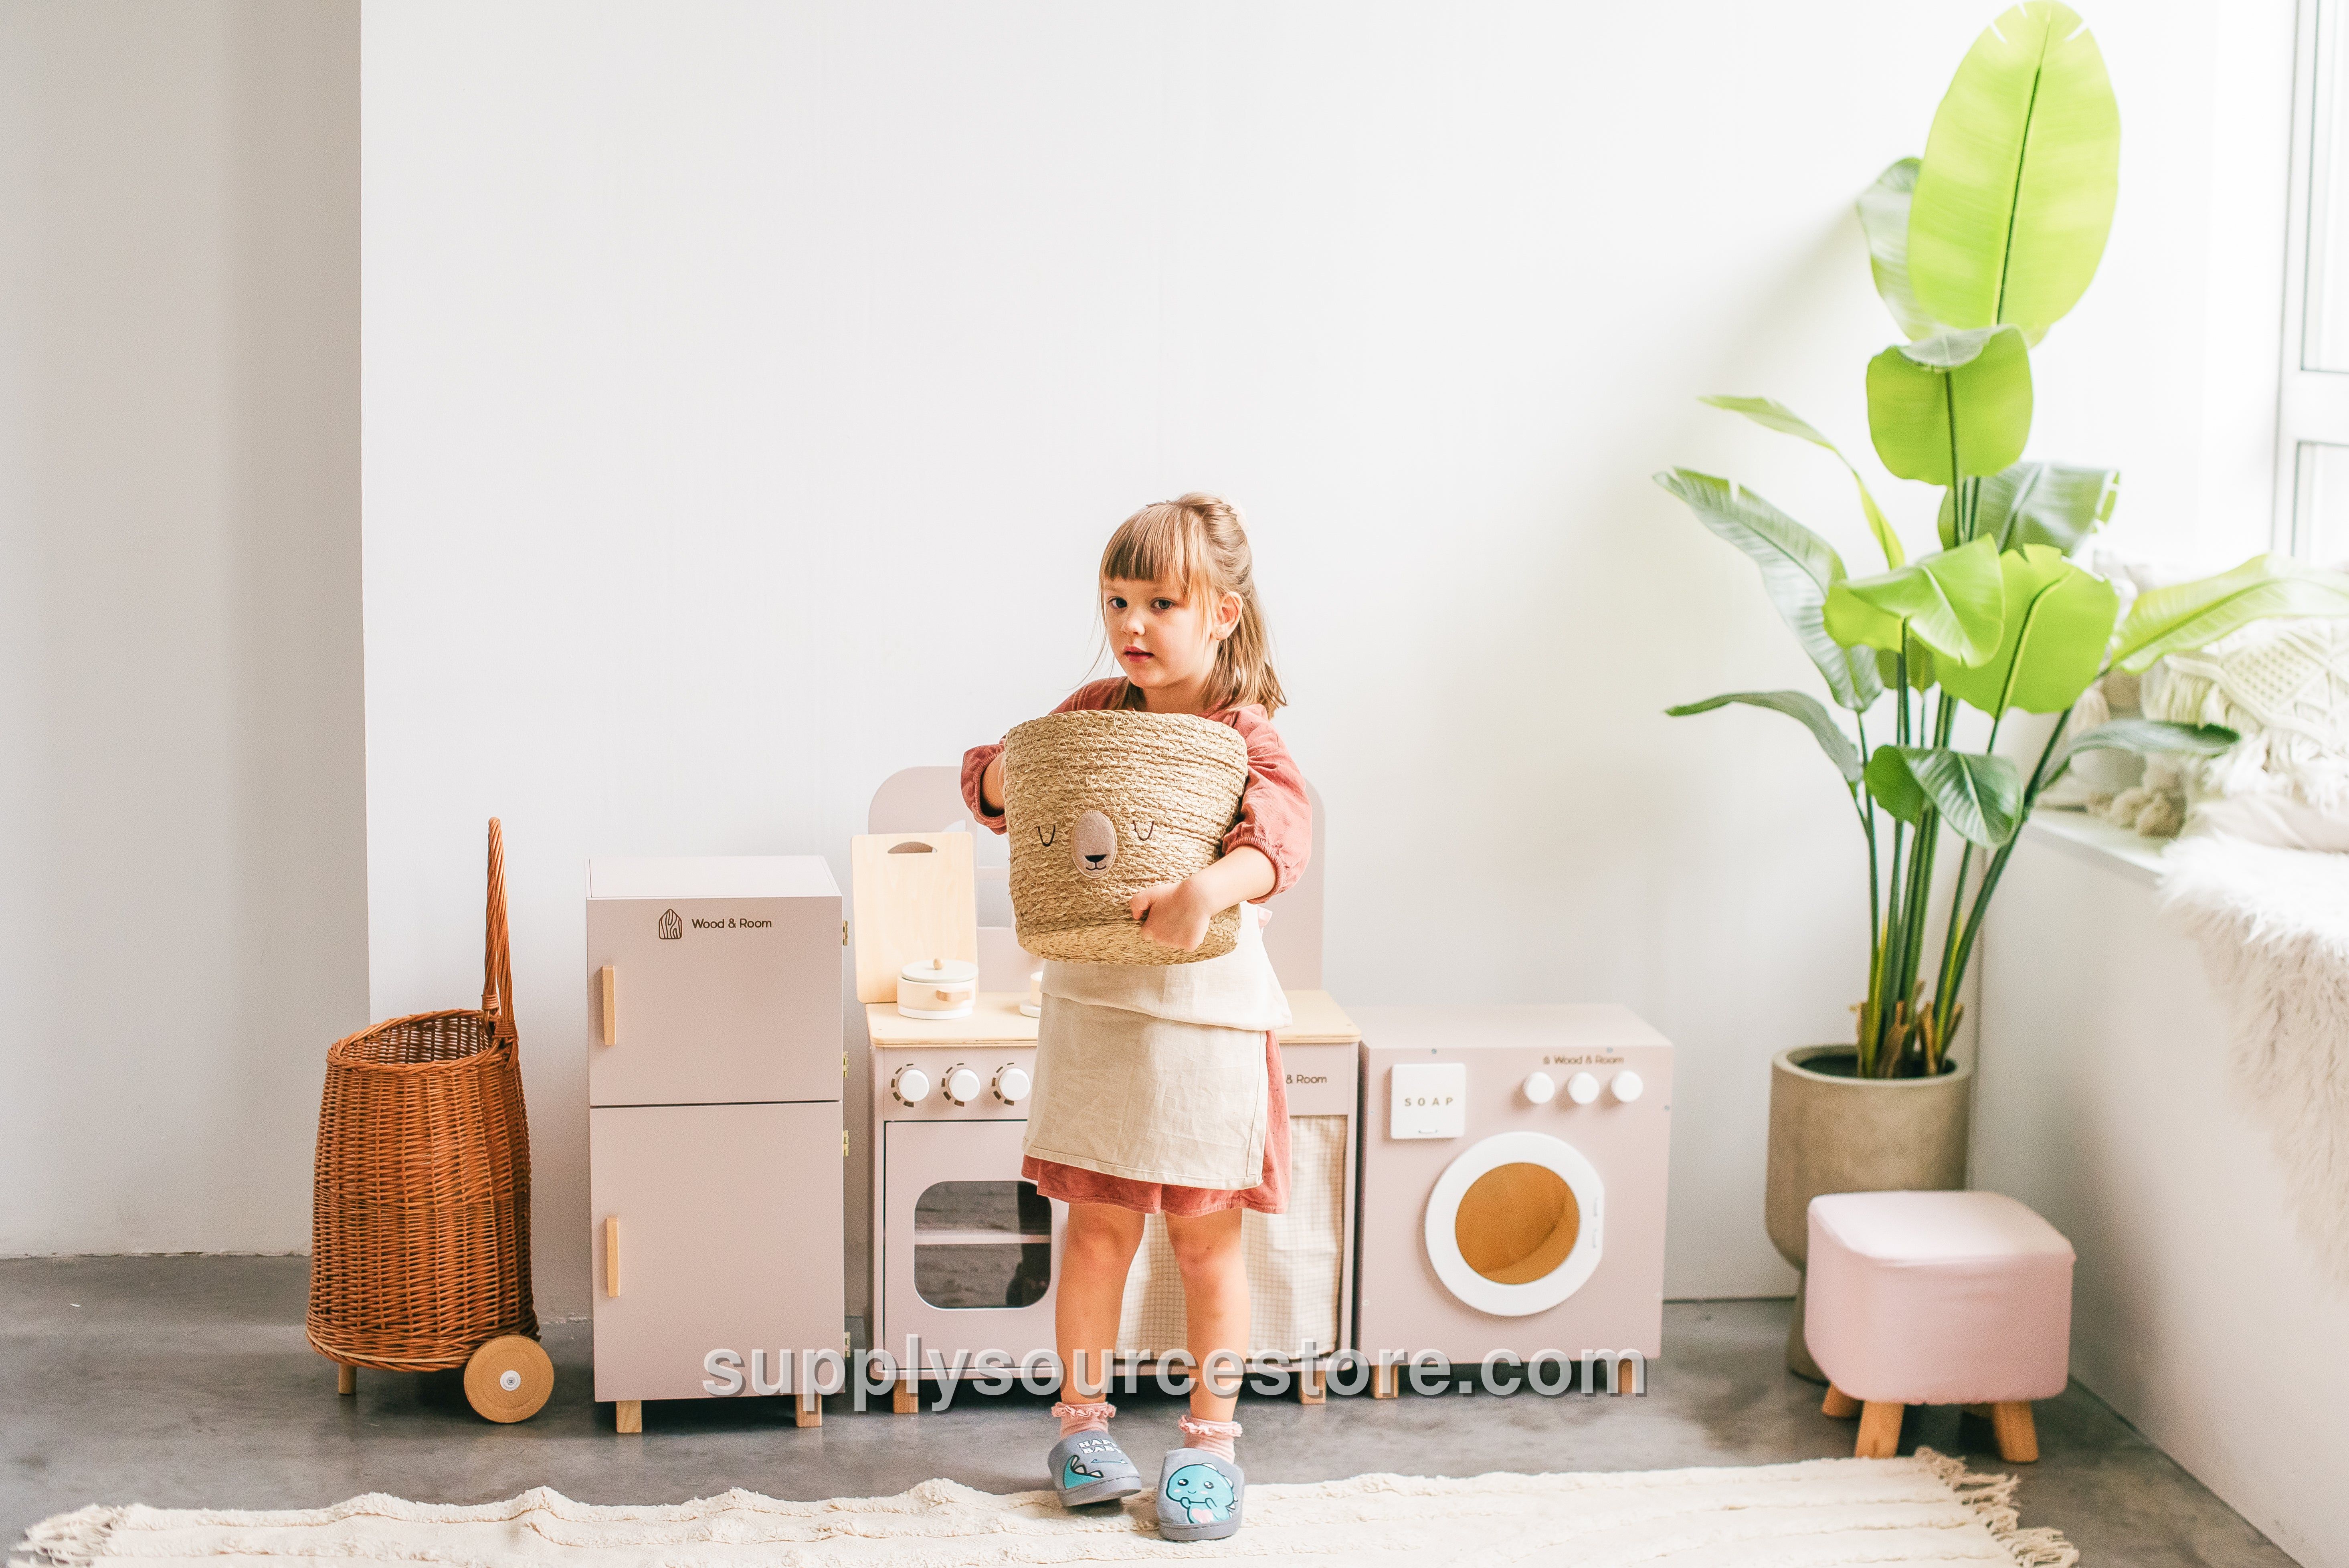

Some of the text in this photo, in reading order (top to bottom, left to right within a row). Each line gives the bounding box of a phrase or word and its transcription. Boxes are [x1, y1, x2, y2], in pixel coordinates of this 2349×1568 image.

[691, 918, 772, 928] Wood & Room
[1553, 1055, 1583, 1064] Wood
[1595, 1054, 1624, 1064] Room
[1286, 1075, 1327, 1084] & Room
[1405, 1097, 1453, 1107] SOAP
